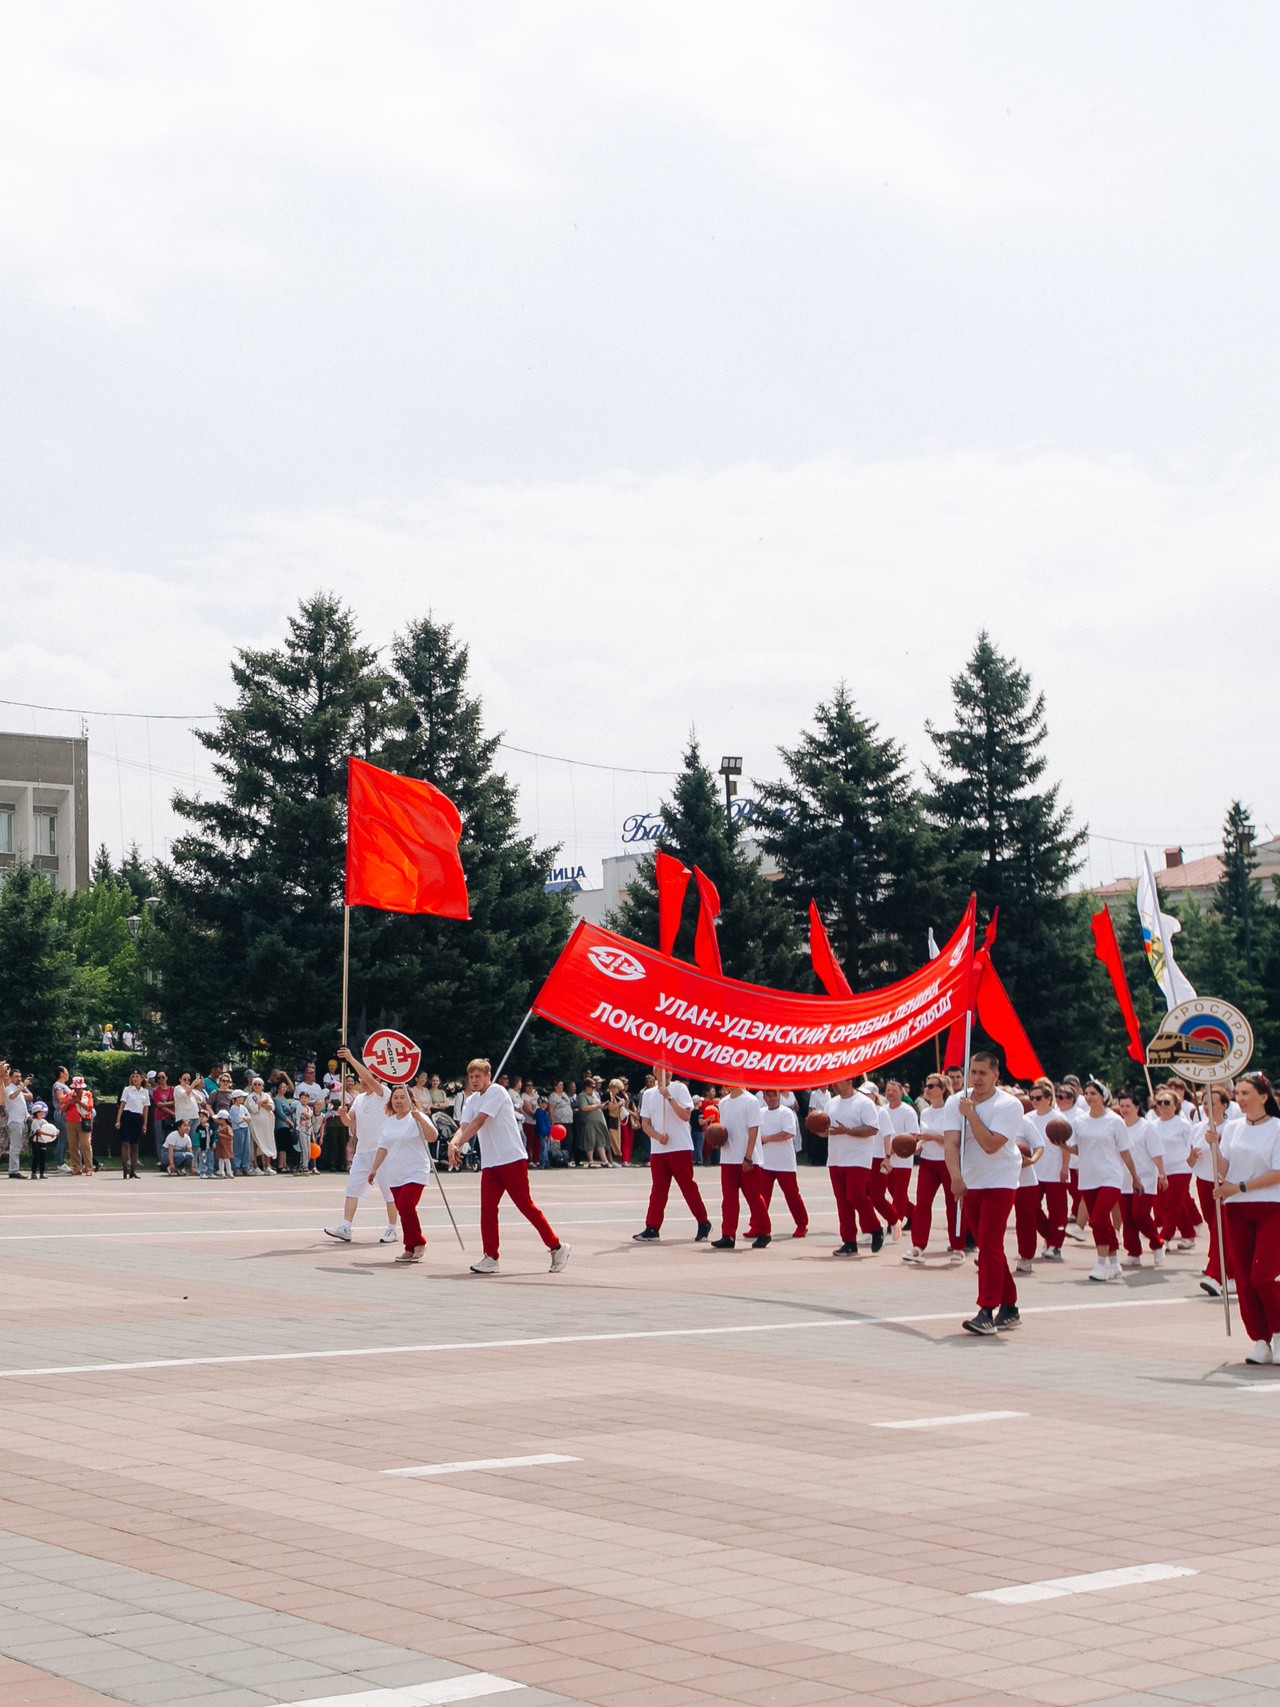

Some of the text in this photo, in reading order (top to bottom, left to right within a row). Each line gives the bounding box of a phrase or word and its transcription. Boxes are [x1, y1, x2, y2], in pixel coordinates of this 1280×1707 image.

[590, 1001, 912, 1073] ЛОКОМОТИВОВАГОНОРЕМОНТНЫЙ
[654, 992, 832, 1044] УЛАН-УДЭНСКИЙ
[829, 1011, 891, 1043] ОРДЕНА
[1179, 1002, 1247, 1078] РОСПРОФЖЕЛ
